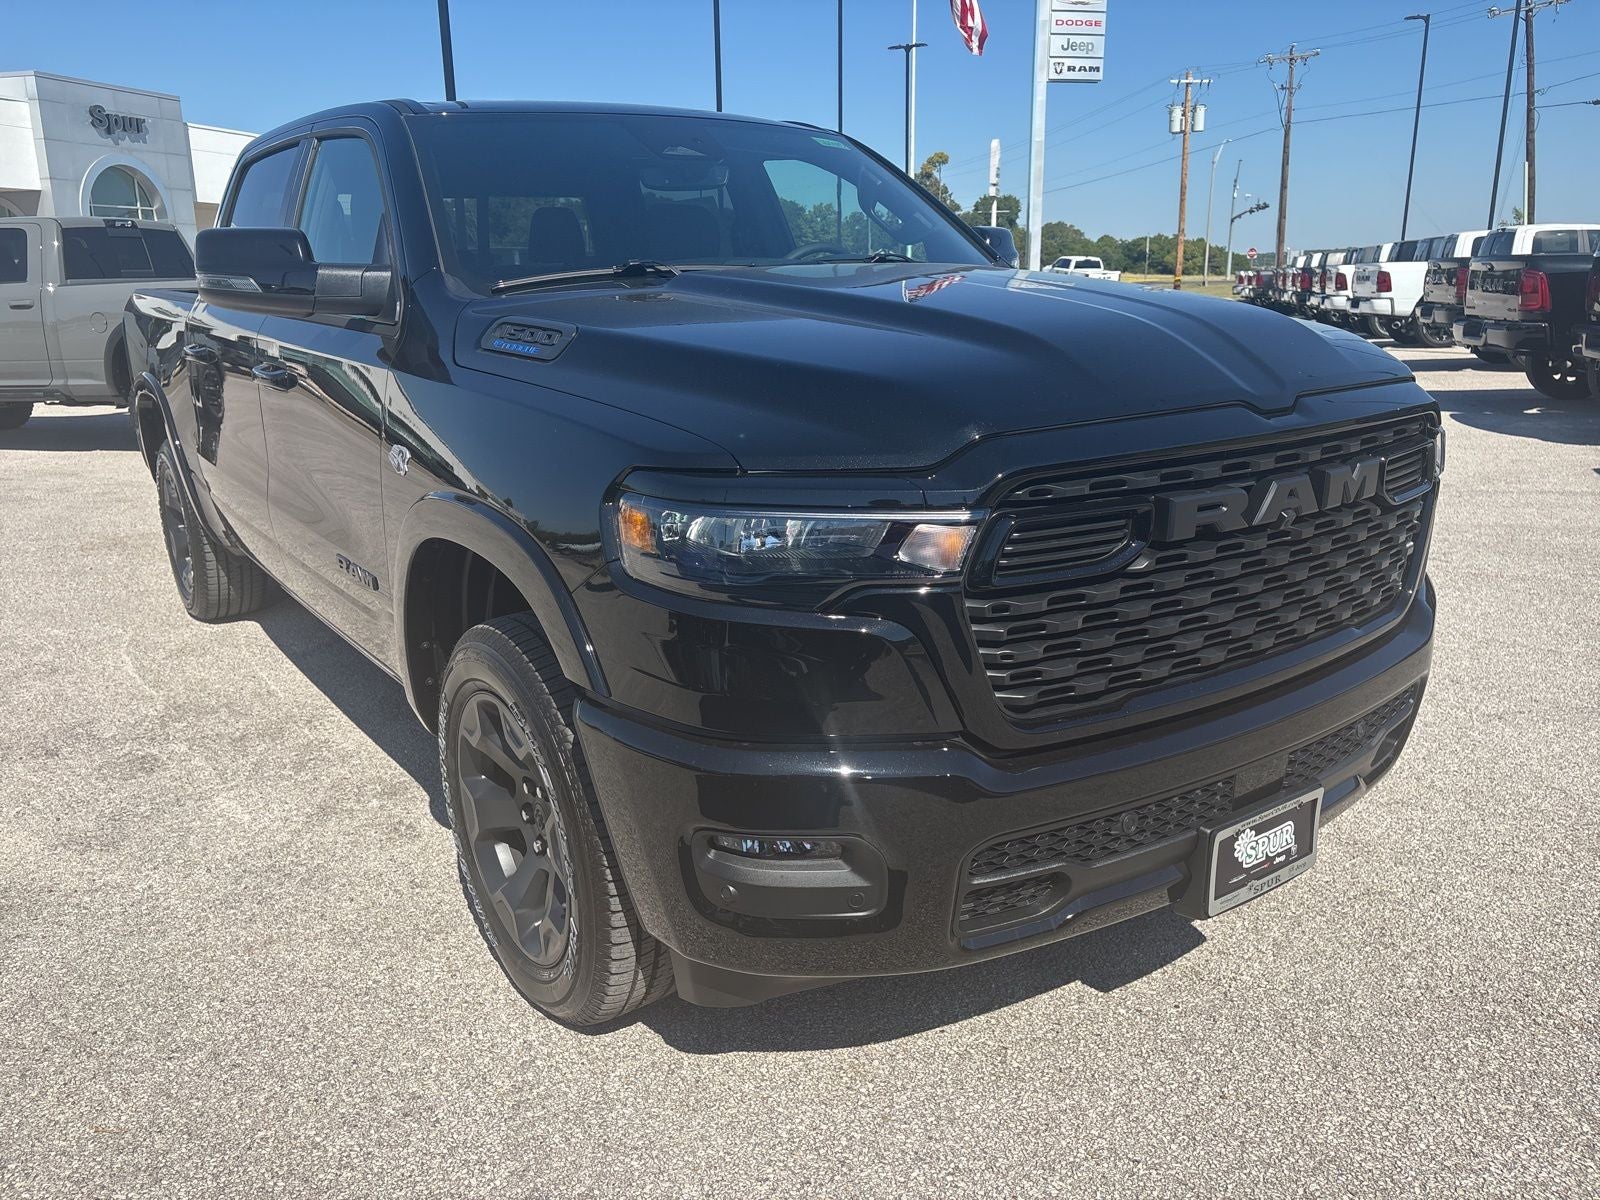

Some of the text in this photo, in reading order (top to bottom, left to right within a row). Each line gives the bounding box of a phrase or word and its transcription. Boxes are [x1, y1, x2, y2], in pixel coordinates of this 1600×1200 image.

[1055, 19, 1103, 27] DODGE
[1061, 38, 1095, 54] Jeep
[1066, 65, 1101, 73] RAM
[89, 104, 147, 136] Spur
[1151, 455, 1381, 542] RAM
[335, 552, 380, 592] RAM
[1243, 822, 1295, 868] SPUR
[1253, 874, 1282, 894] SPUR
